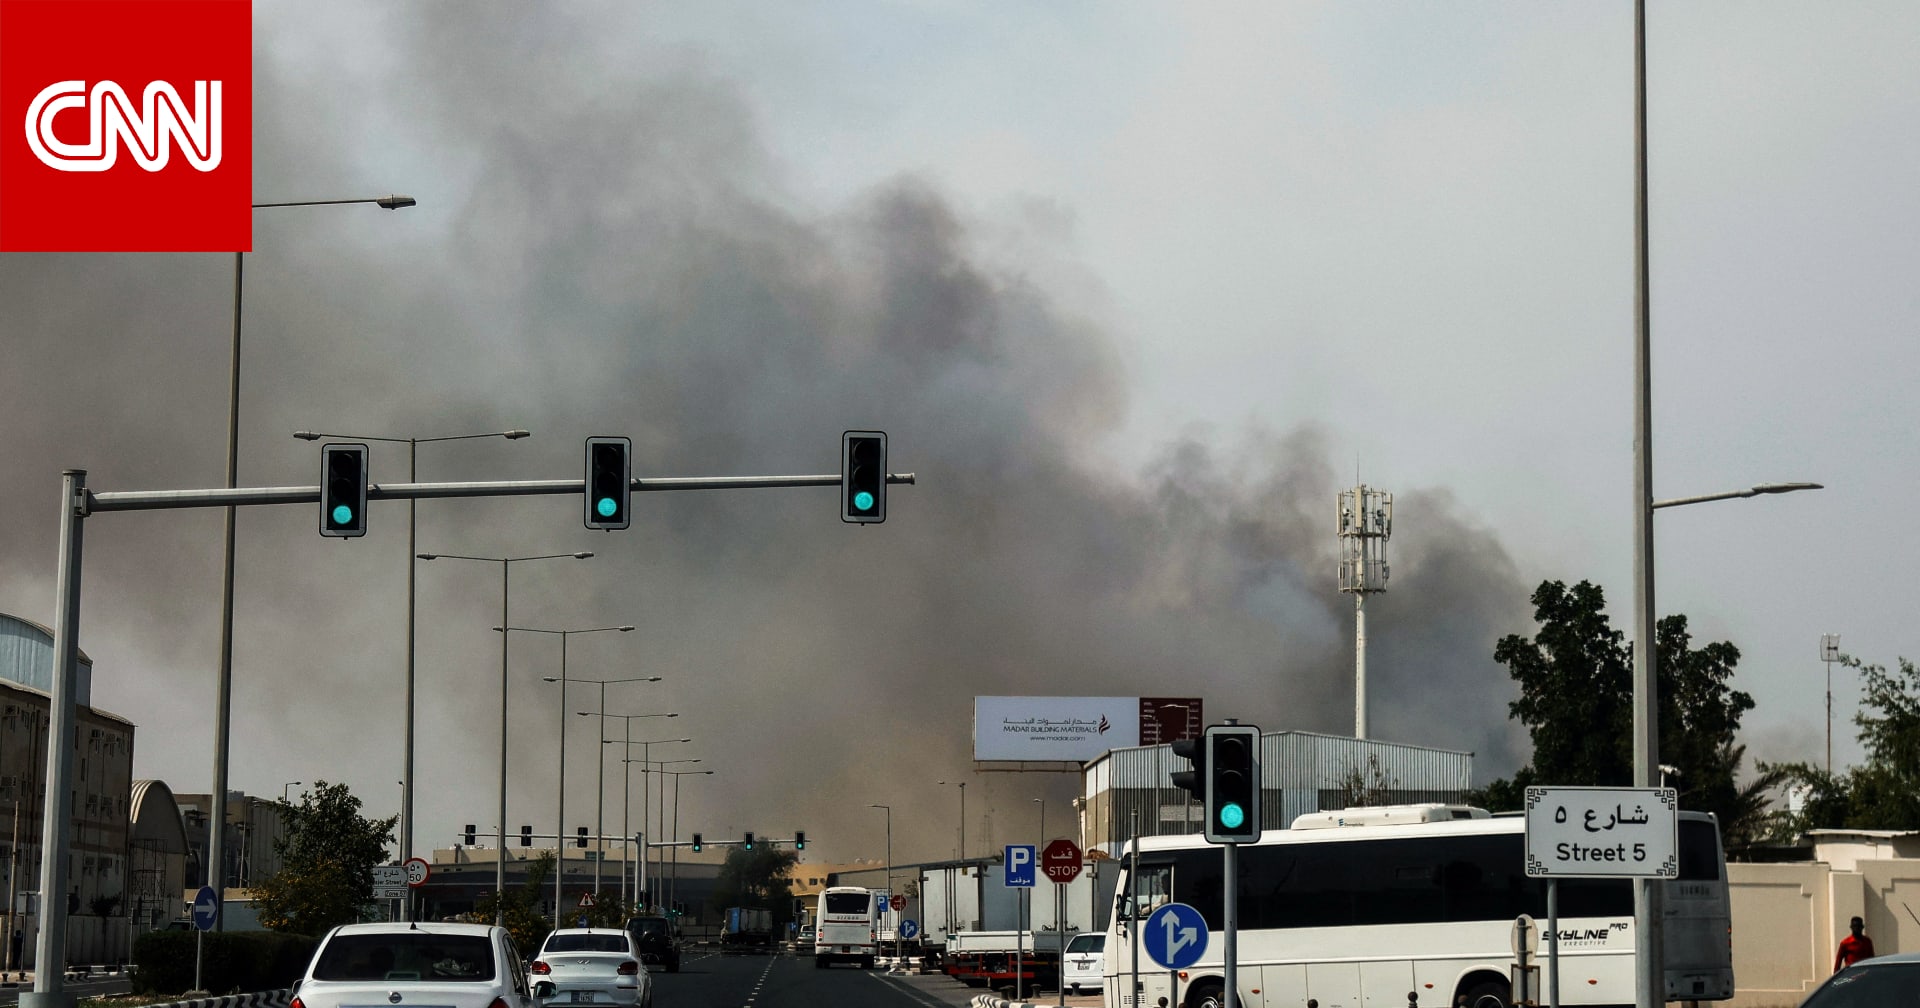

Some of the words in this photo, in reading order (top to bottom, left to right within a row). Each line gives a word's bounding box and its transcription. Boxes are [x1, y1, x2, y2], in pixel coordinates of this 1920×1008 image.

[1071, 717, 1098, 726] مدار
[1555, 805, 1567, 824] ٥
[1583, 803, 1649, 833] شارع
[1051, 848, 1073, 860] قف
[1556, 842, 1626, 862] Street
[1632, 843, 1647, 862] 5
[1011, 848, 1029, 873] P
[1049, 866, 1078, 876] STOP
[409, 873, 422, 882] 50
[1009, 876, 1031, 885] موقف
[877, 896, 885, 906] P
[1609, 922, 1629, 932] PRO
